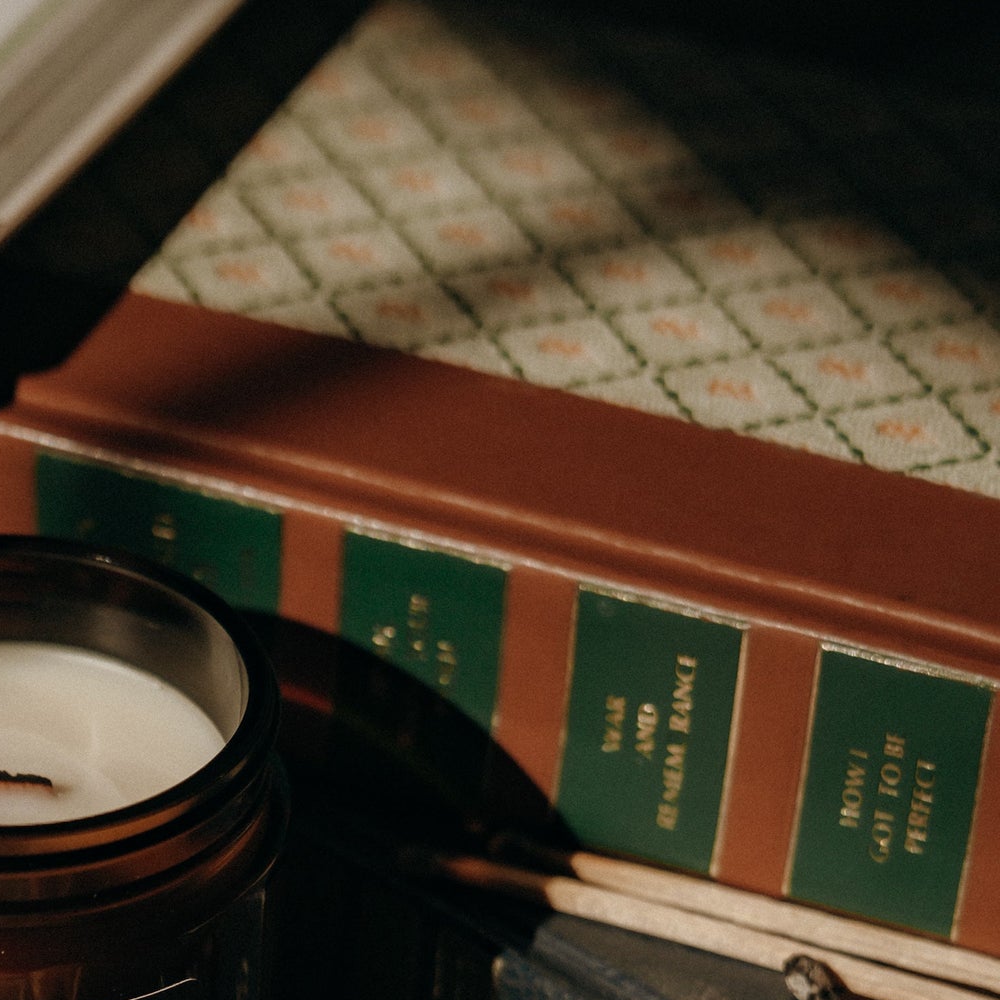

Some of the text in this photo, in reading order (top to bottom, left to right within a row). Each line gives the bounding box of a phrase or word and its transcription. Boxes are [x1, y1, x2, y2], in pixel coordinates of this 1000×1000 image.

[635, 703, 658, 760] AND
[839, 762, 866, 828] HOW
[878, 762, 902, 798] TO
[904, 757, 937, 855] PERFECT
[869, 809, 895, 864] GOT
